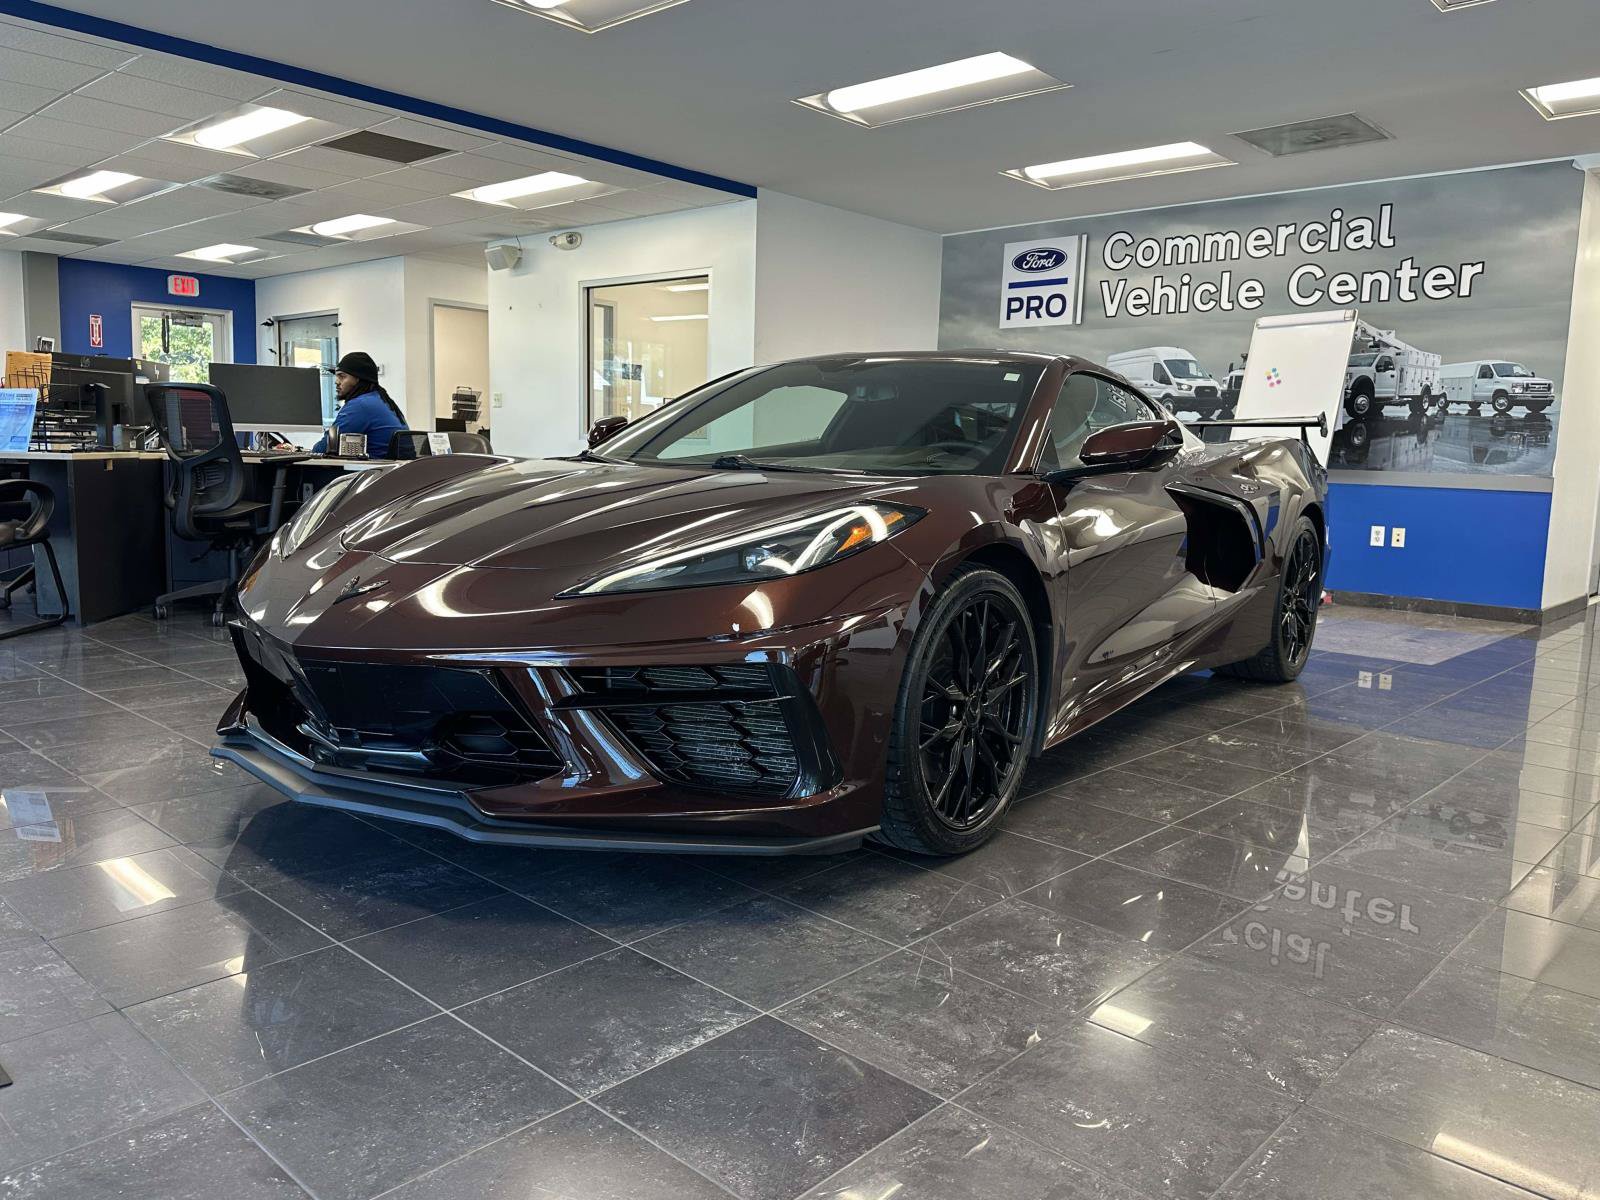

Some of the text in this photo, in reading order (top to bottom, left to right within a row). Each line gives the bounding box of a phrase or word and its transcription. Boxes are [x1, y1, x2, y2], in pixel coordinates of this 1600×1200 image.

[1102, 203, 1395, 271] Commercial
[1021, 251, 1058, 270] Ford
[174, 276, 195, 294] EXIT
[1100, 257, 1485, 318] Vehicle Center
[1006, 293, 1067, 321] PRO
